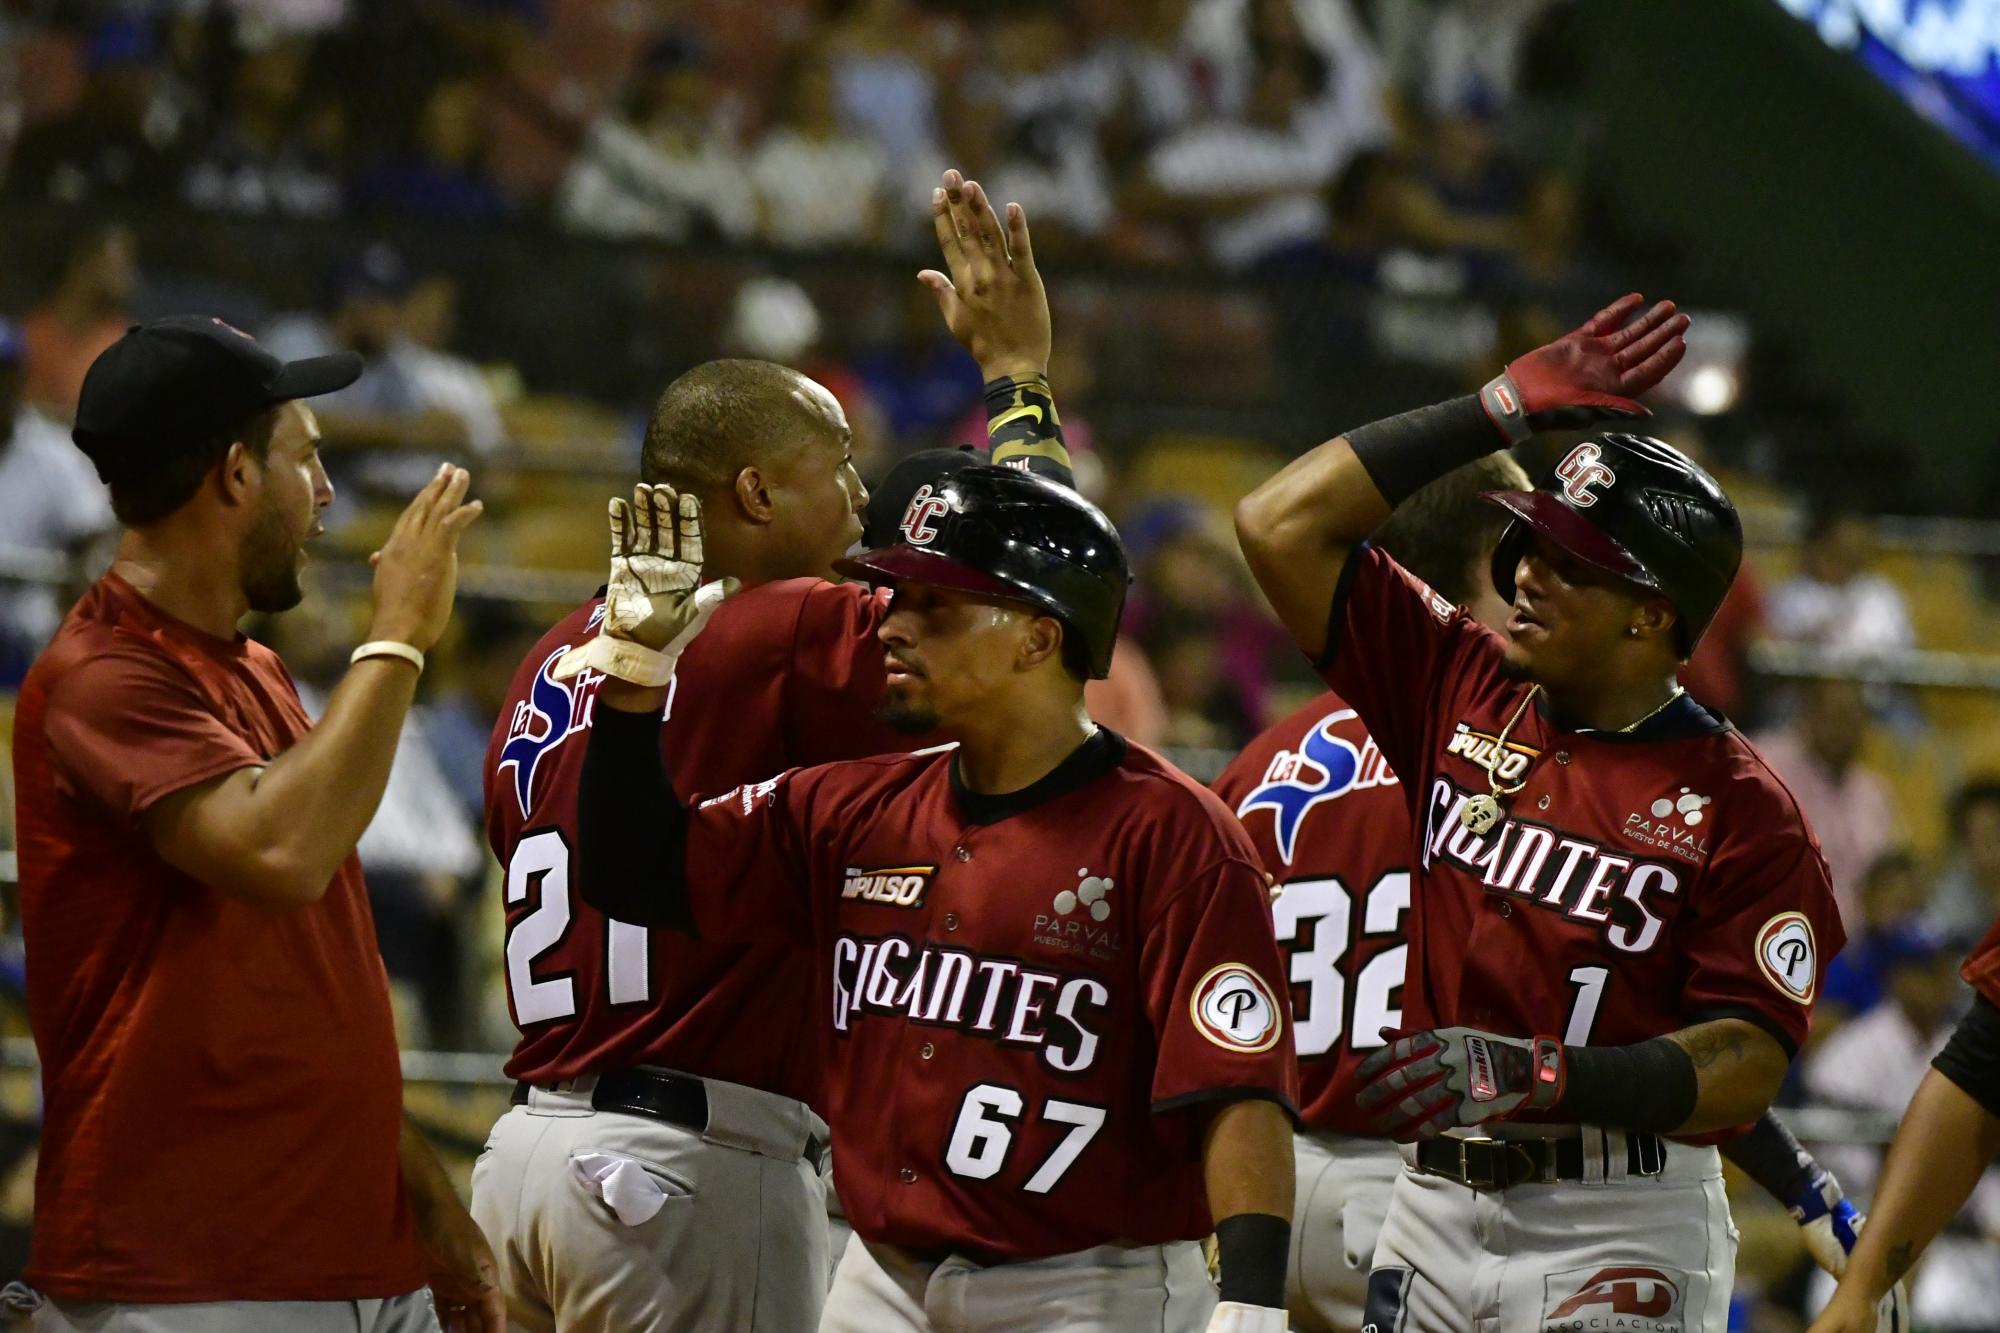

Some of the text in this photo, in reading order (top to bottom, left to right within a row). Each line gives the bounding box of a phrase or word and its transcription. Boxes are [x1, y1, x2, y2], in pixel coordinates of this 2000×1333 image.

[1623, 828, 1655, 845] PUESTO
[1657, 840, 1671, 849] DE
[1625, 812, 1708, 855] PARVAL
[1272, 872, 1411, 1056] 32
[1776, 938, 1807, 977] P
[832, 938, 1108, 1071] GIGANTES
[1217, 989, 1257, 1030] P
[1564, 966, 1609, 1048] 1
[945, 1084, 1107, 1194] 67
